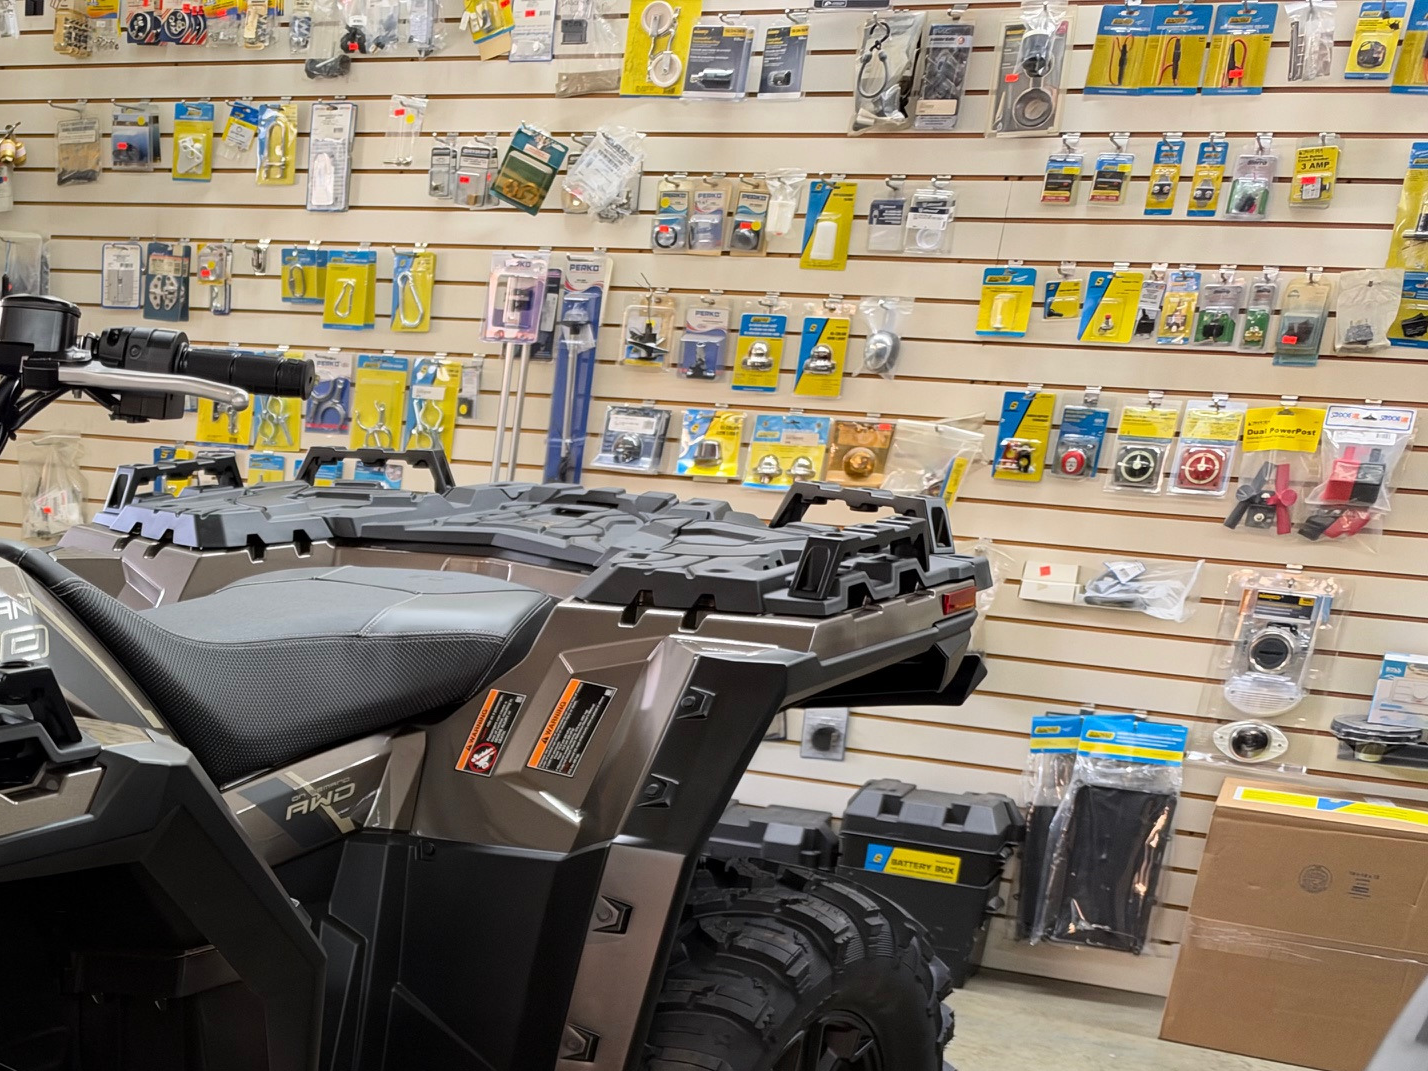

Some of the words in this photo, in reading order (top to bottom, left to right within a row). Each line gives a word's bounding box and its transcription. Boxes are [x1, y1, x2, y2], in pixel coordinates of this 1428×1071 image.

[1309, 161, 1330, 170] AMP
[569, 264, 600, 272] PERKO
[1247, 428, 1268, 436] Dual
[1270, 427, 1316, 436] PowerPost
[470, 709, 488, 739] WARNING
[544, 701, 567, 736] WARNING
[285, 782, 356, 821] AWD
[891, 858, 932, 870] BATTERY
[934, 865, 954, 875] BOX
